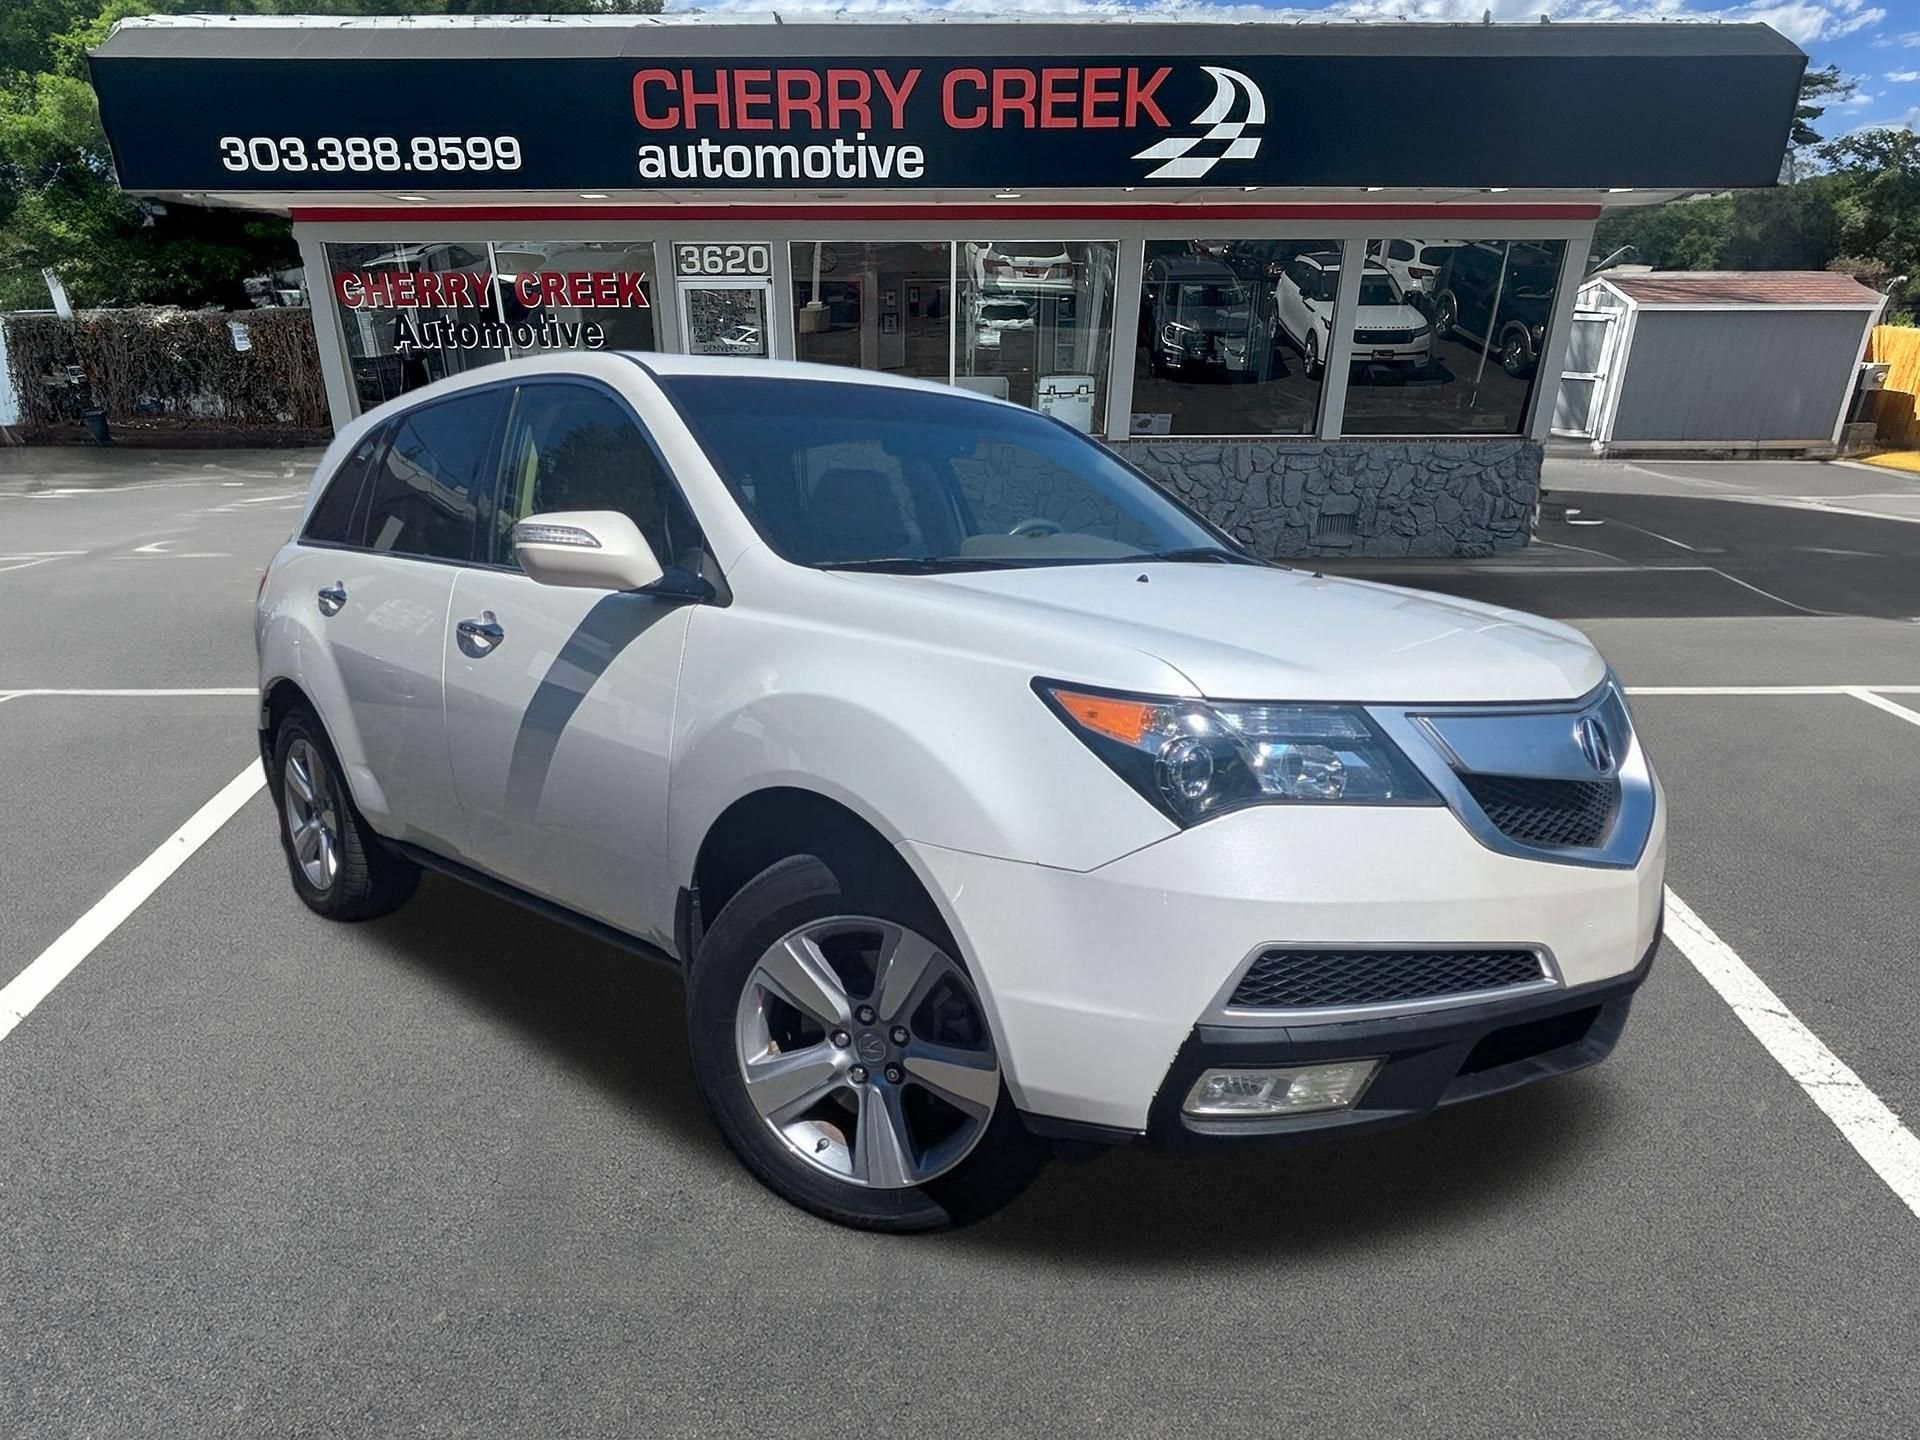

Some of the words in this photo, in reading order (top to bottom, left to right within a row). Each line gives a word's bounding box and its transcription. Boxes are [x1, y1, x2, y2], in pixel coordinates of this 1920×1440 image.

[632, 68, 921, 130] CHERRY
[941, 67, 1172, 128] CREEK
[219, 136, 522, 172] 303.388.8599
[638, 132, 925, 179] automotive
[680, 246, 769, 274] 3620
[335, 271, 494, 309] CHERRY
[514, 271, 651, 309] CREEK
[393, 313, 607, 350] Automotive
